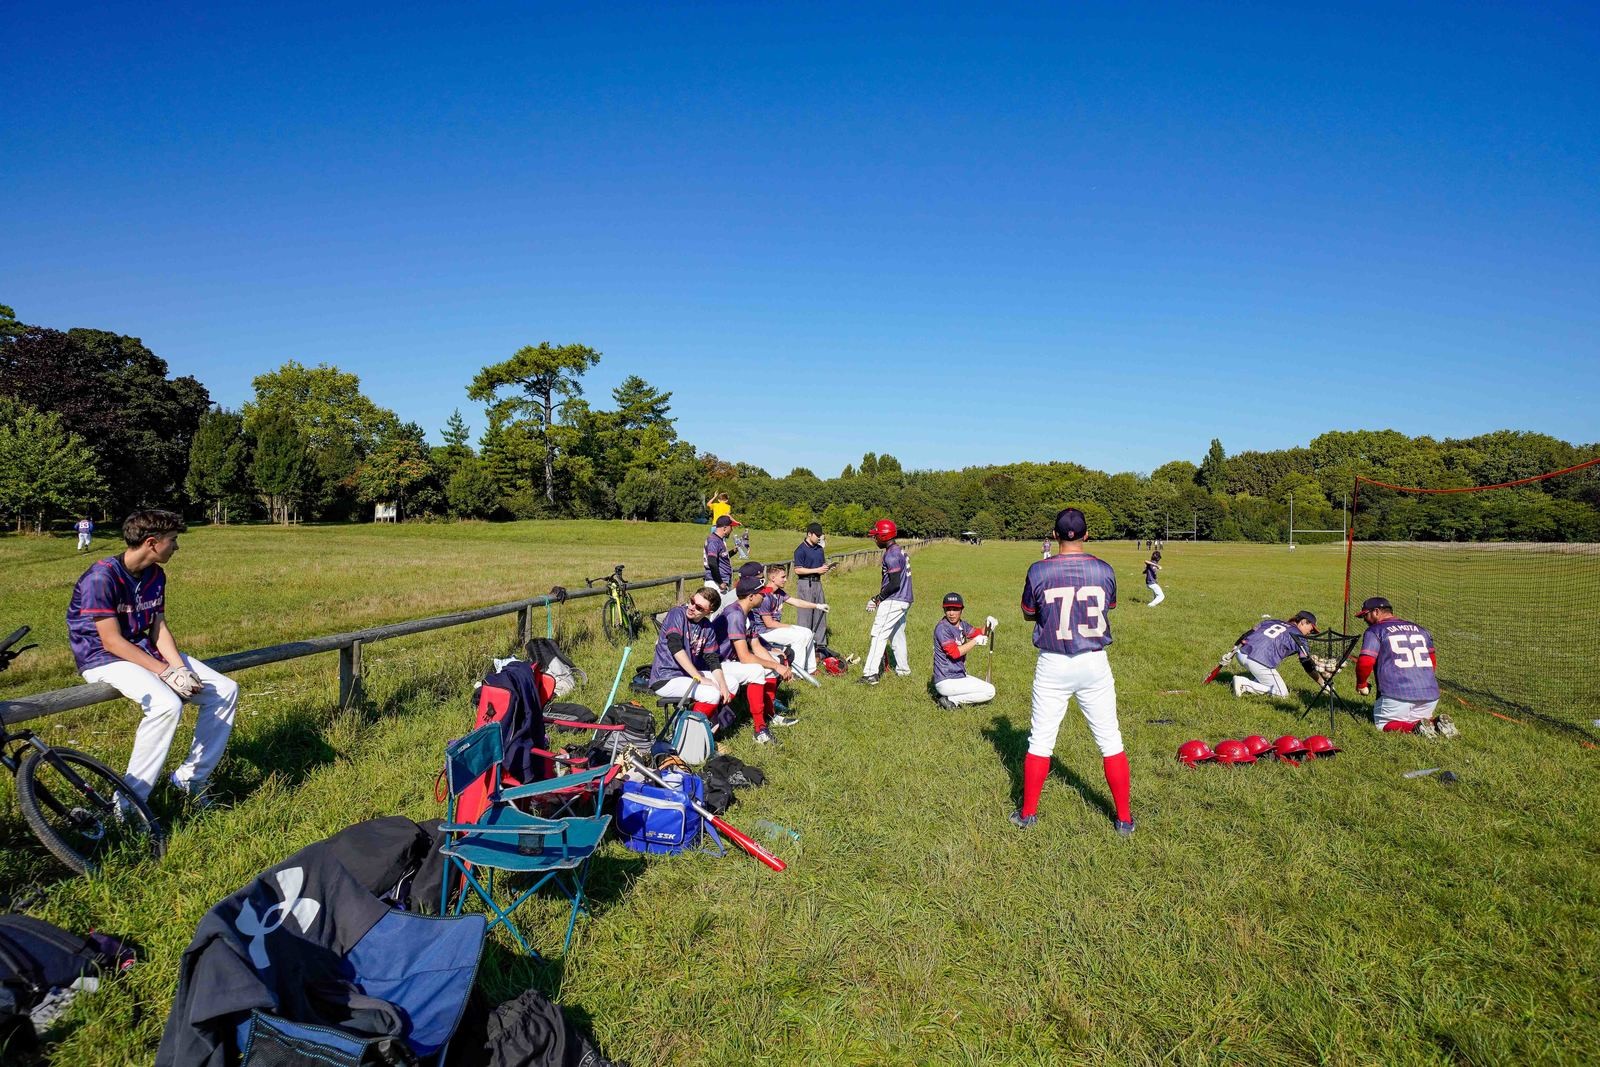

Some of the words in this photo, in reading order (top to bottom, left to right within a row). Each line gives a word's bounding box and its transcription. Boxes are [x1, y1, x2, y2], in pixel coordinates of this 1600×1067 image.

[1043, 586, 1107, 640] 73
[1263, 624, 1287, 639] 8
[1397, 624, 1420, 633] MOTA
[1388, 634, 1433, 669] 52
